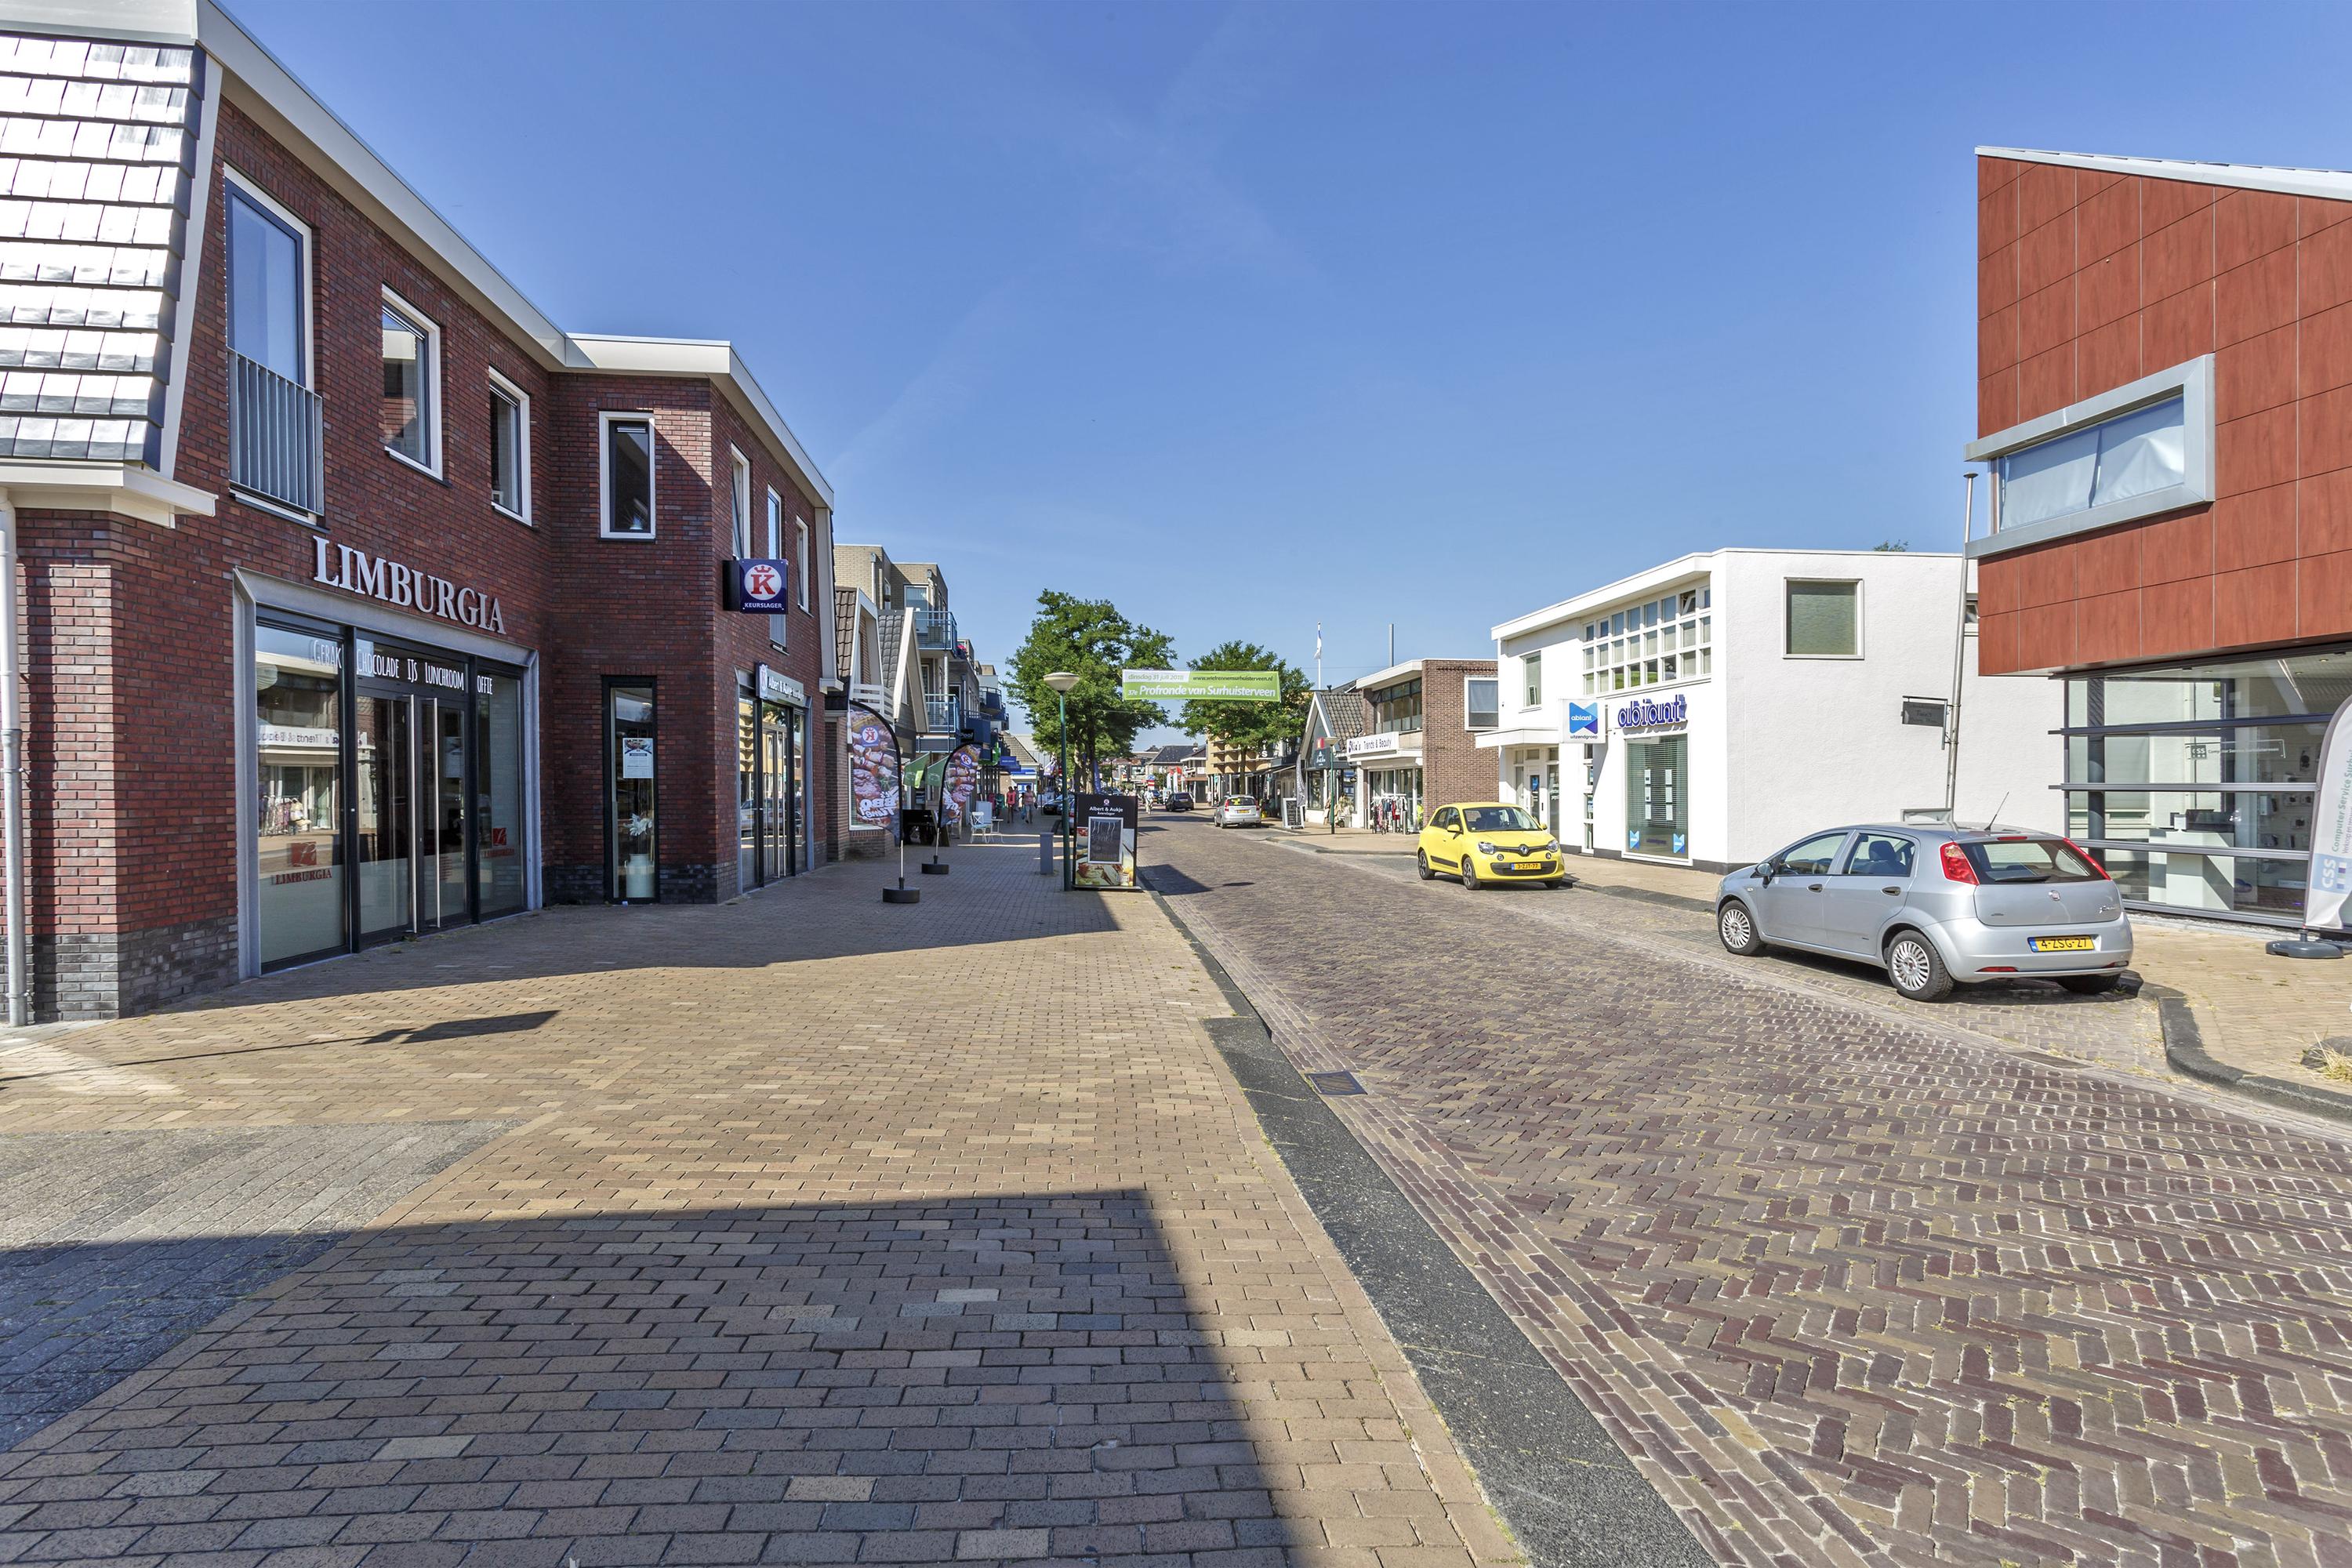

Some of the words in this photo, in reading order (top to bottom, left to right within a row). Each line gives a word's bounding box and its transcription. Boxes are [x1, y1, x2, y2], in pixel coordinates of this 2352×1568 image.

[313, 535, 506, 635] LIMBURGIA
[750, 574, 775, 595] K
[477, 674, 493, 695] OFFIE
[1127, 673, 1152, 681] dinsdag
[1139, 684, 1187, 696] Profronde
[1189, 687, 1206, 695] van
[1207, 685, 1276, 697] Surhuisterveen
[1617, 695, 1682, 728] abiant
[2338, 779, 2352, 810] Service
[2332, 810, 2346, 853] Computer
[274, 868, 332, 885] LIMBURGIA
[2321, 858, 2336, 889] CSS
[2041, 938, 2088, 949] 4-ZSG-27
